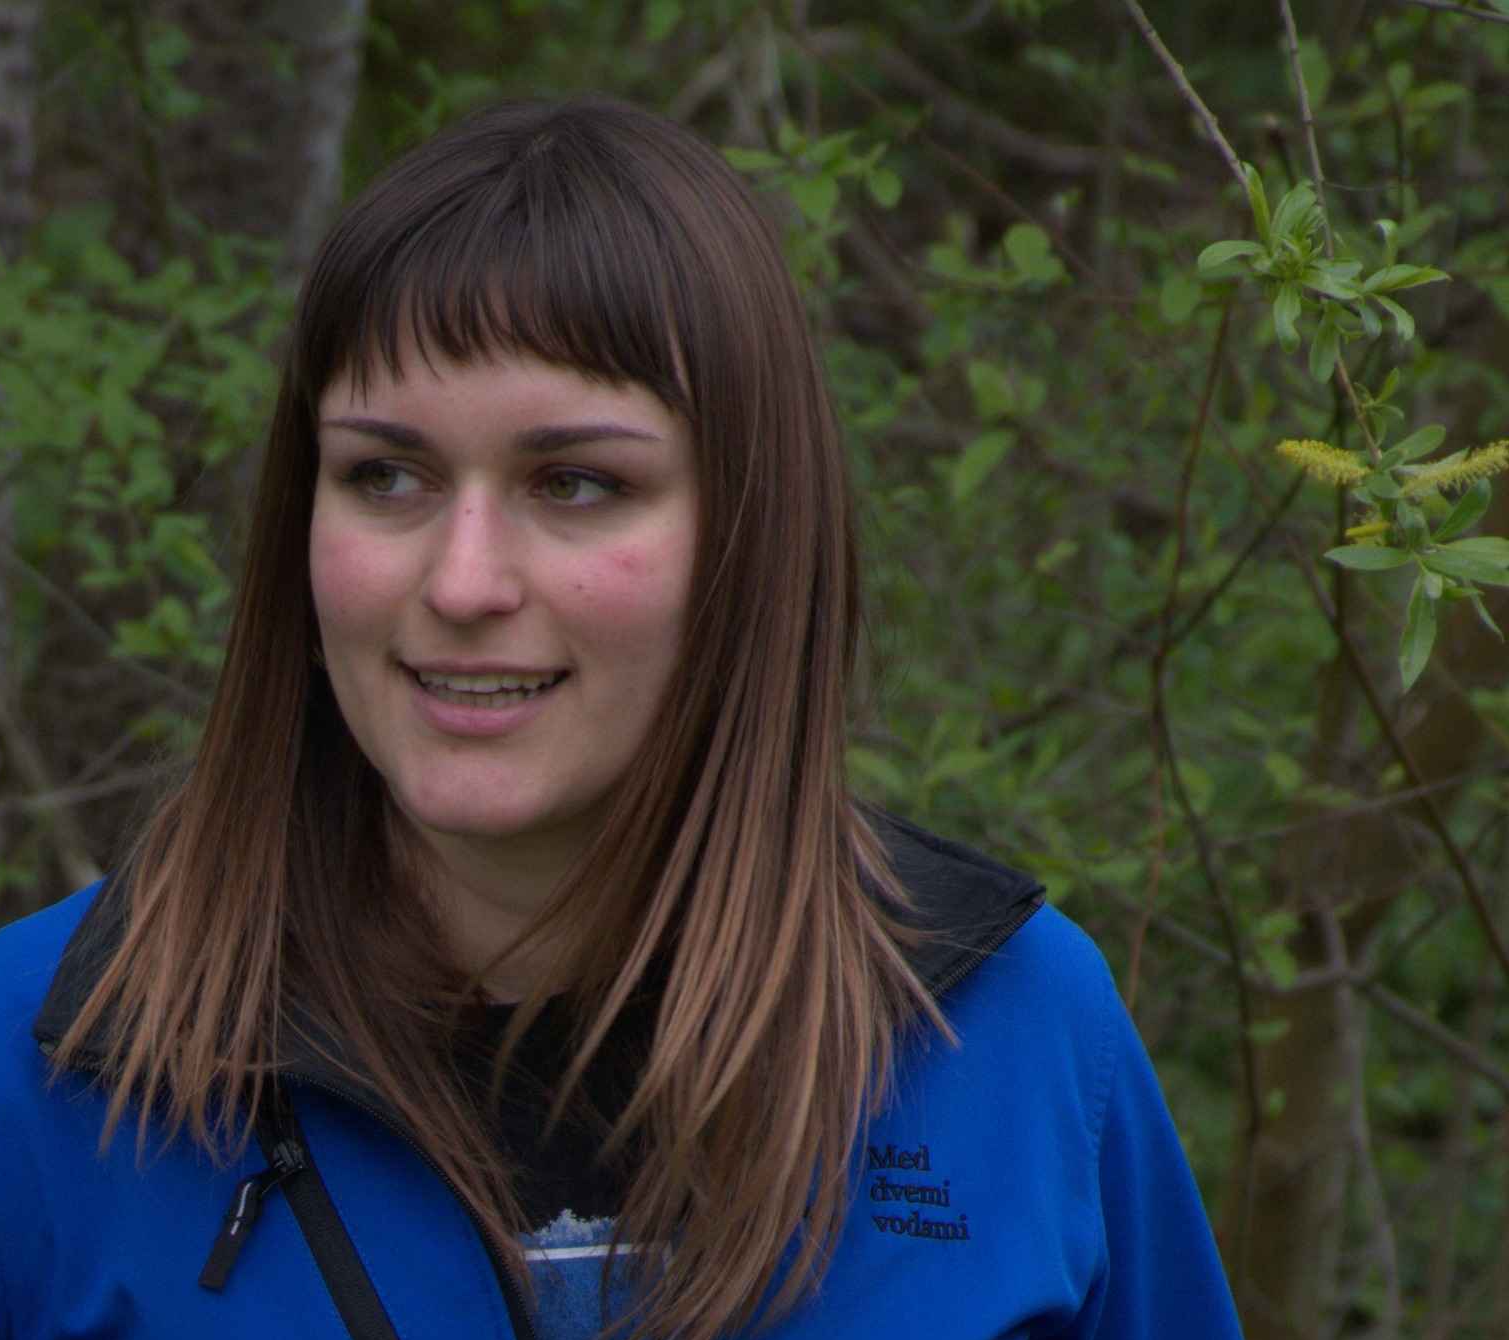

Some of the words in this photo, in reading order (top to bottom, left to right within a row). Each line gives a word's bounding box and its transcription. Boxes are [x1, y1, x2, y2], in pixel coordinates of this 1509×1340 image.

[868, 1144, 931, 1171] Med
[869, 1176, 951, 1207] dvemi
[871, 1211, 970, 1240] vodami
